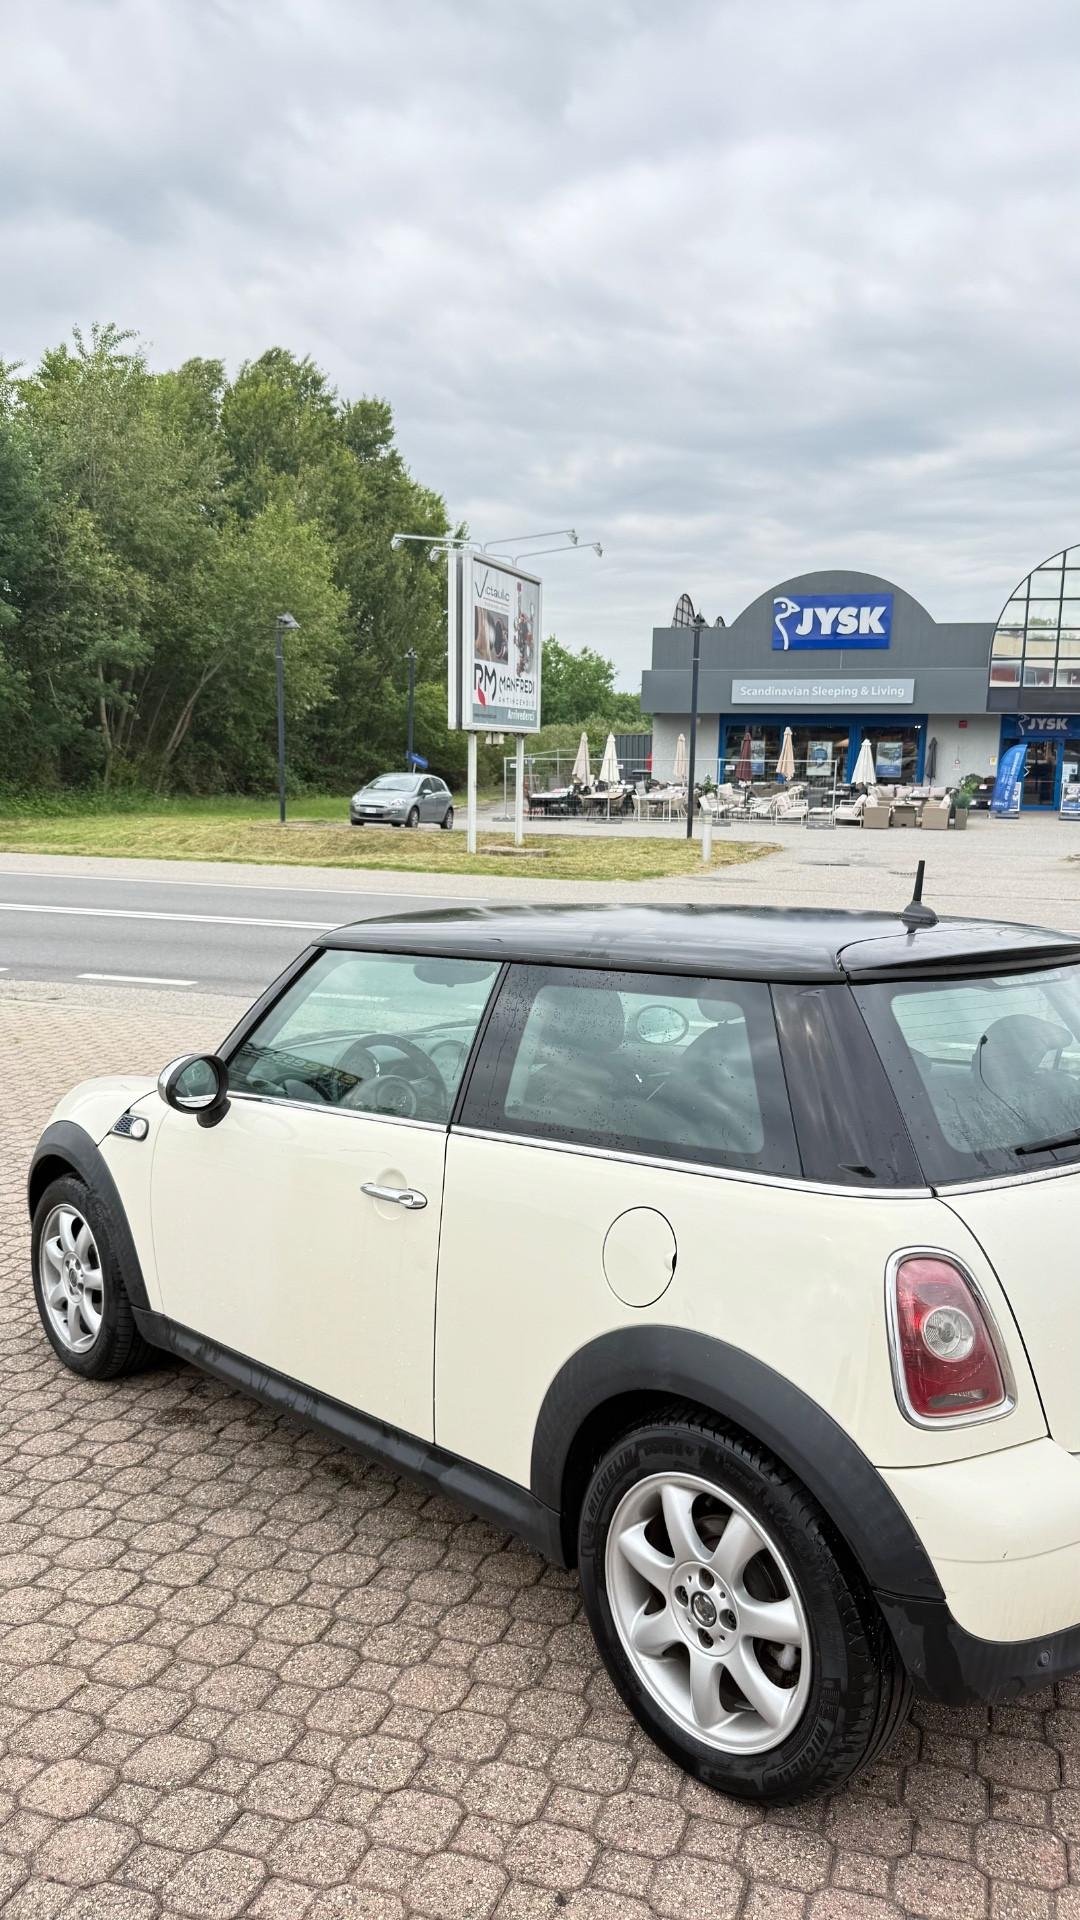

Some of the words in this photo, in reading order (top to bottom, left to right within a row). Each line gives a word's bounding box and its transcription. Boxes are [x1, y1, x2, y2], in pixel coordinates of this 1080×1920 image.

[795, 606, 887, 636] JYSK
[499, 676, 535, 695] MANFREDI
[740, 686, 810, 697] Scandinavian
[812, 685, 858, 698] Sleeping
[860, 685, 869, 696] &
[871, 685, 905, 698] Living
[1028, 718, 1068, 730] JYSK
[587, 1445, 640, 1519] MICHELIN
